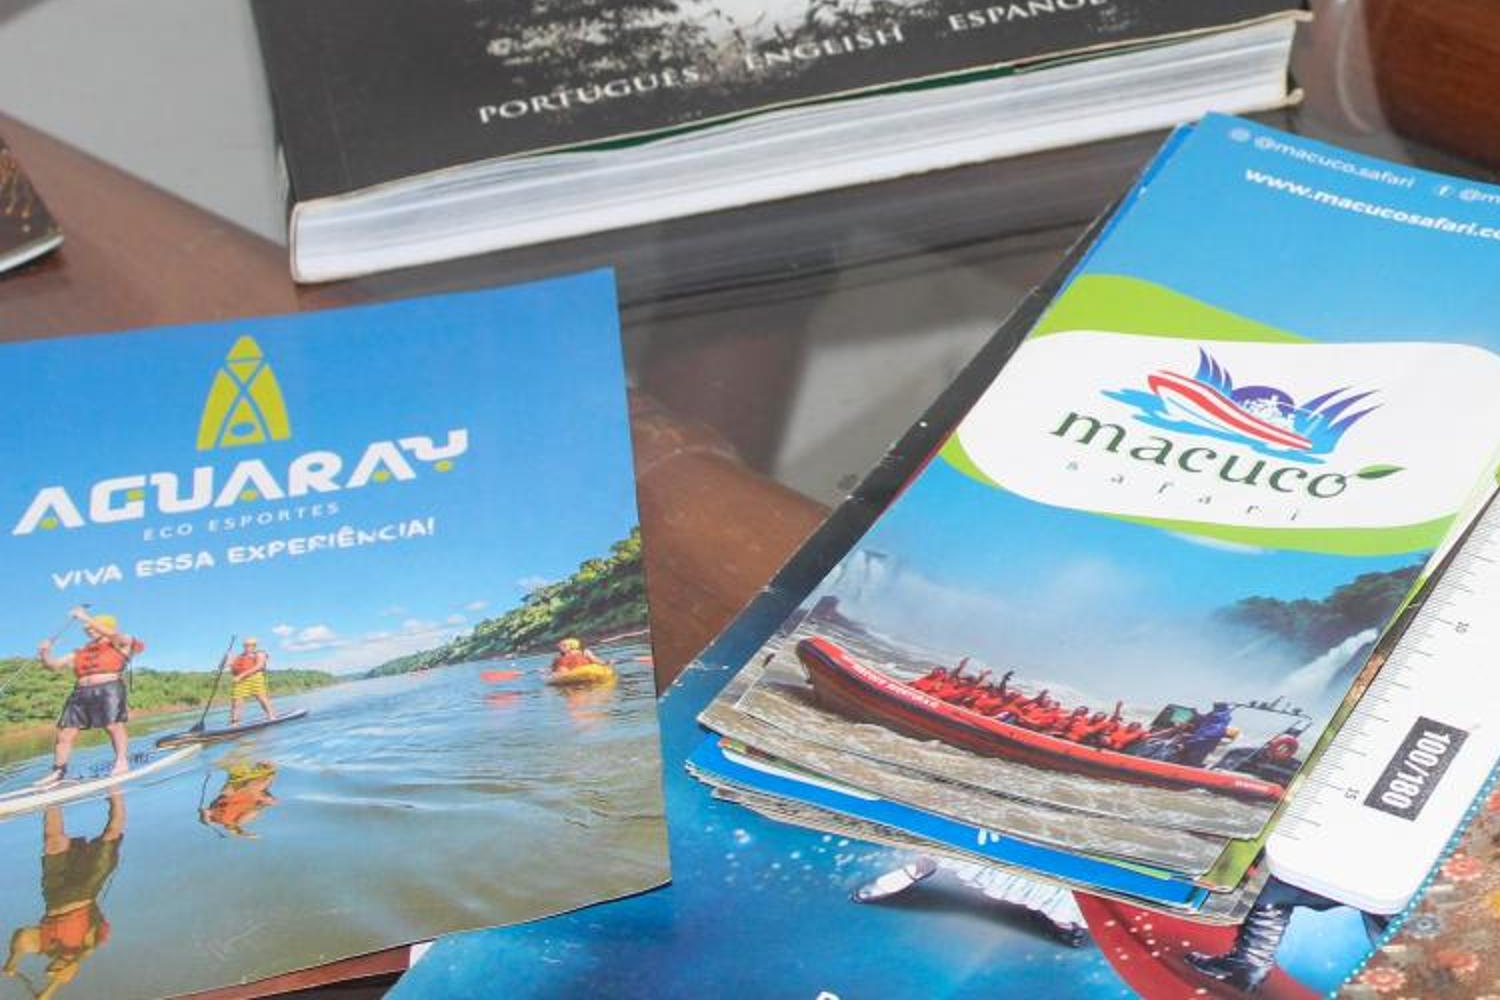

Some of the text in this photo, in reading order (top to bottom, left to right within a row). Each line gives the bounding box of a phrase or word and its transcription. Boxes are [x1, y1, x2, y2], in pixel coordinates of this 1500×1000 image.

[743, 27, 905, 73] ENGLISH
[1254, 135, 1417, 190] @macuco.safari
[11, 428, 469, 537] AGUARAY
[1049, 411, 1348, 499] macuco
[51, 516, 436, 592] VIVA ESSA EXPERIÊNCIA!
[143, 502, 341, 542] ECO ESPORTES
[1381, 730, 1451, 809] 100/180
